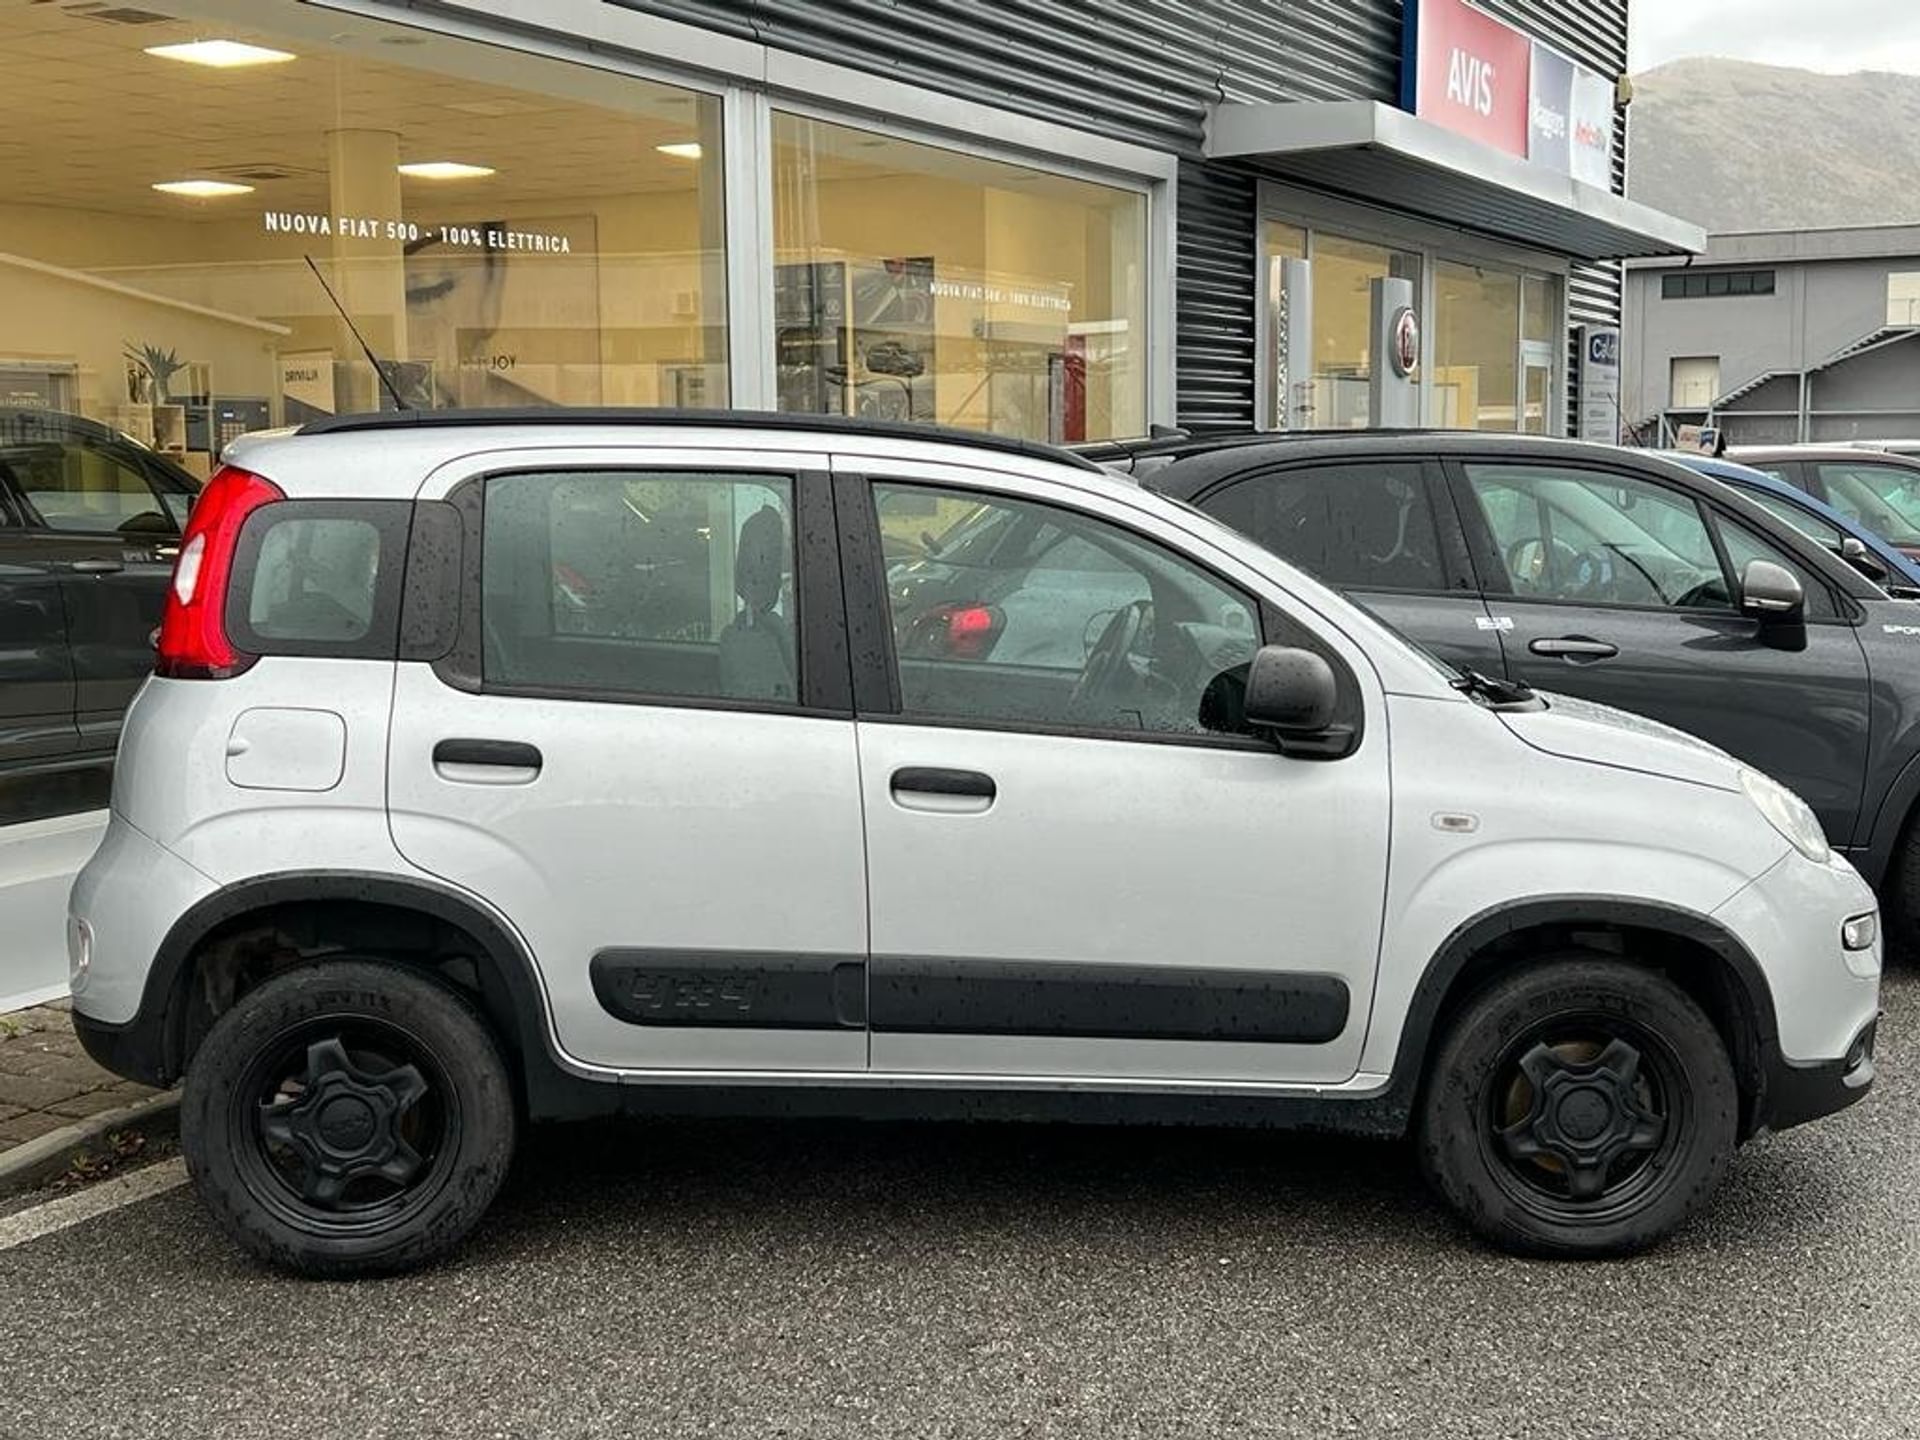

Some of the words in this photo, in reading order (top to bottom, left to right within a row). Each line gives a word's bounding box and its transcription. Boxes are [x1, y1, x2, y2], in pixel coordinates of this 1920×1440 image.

[1447, 48, 1491, 117] AVIS
[265, 211, 331, 235] NUOVA
[339, 217, 379, 239] FIAT
[387, 221, 418, 241] 500
[440, 226, 482, 247] 100%
[488, 230, 570, 254] ELETTRICA
